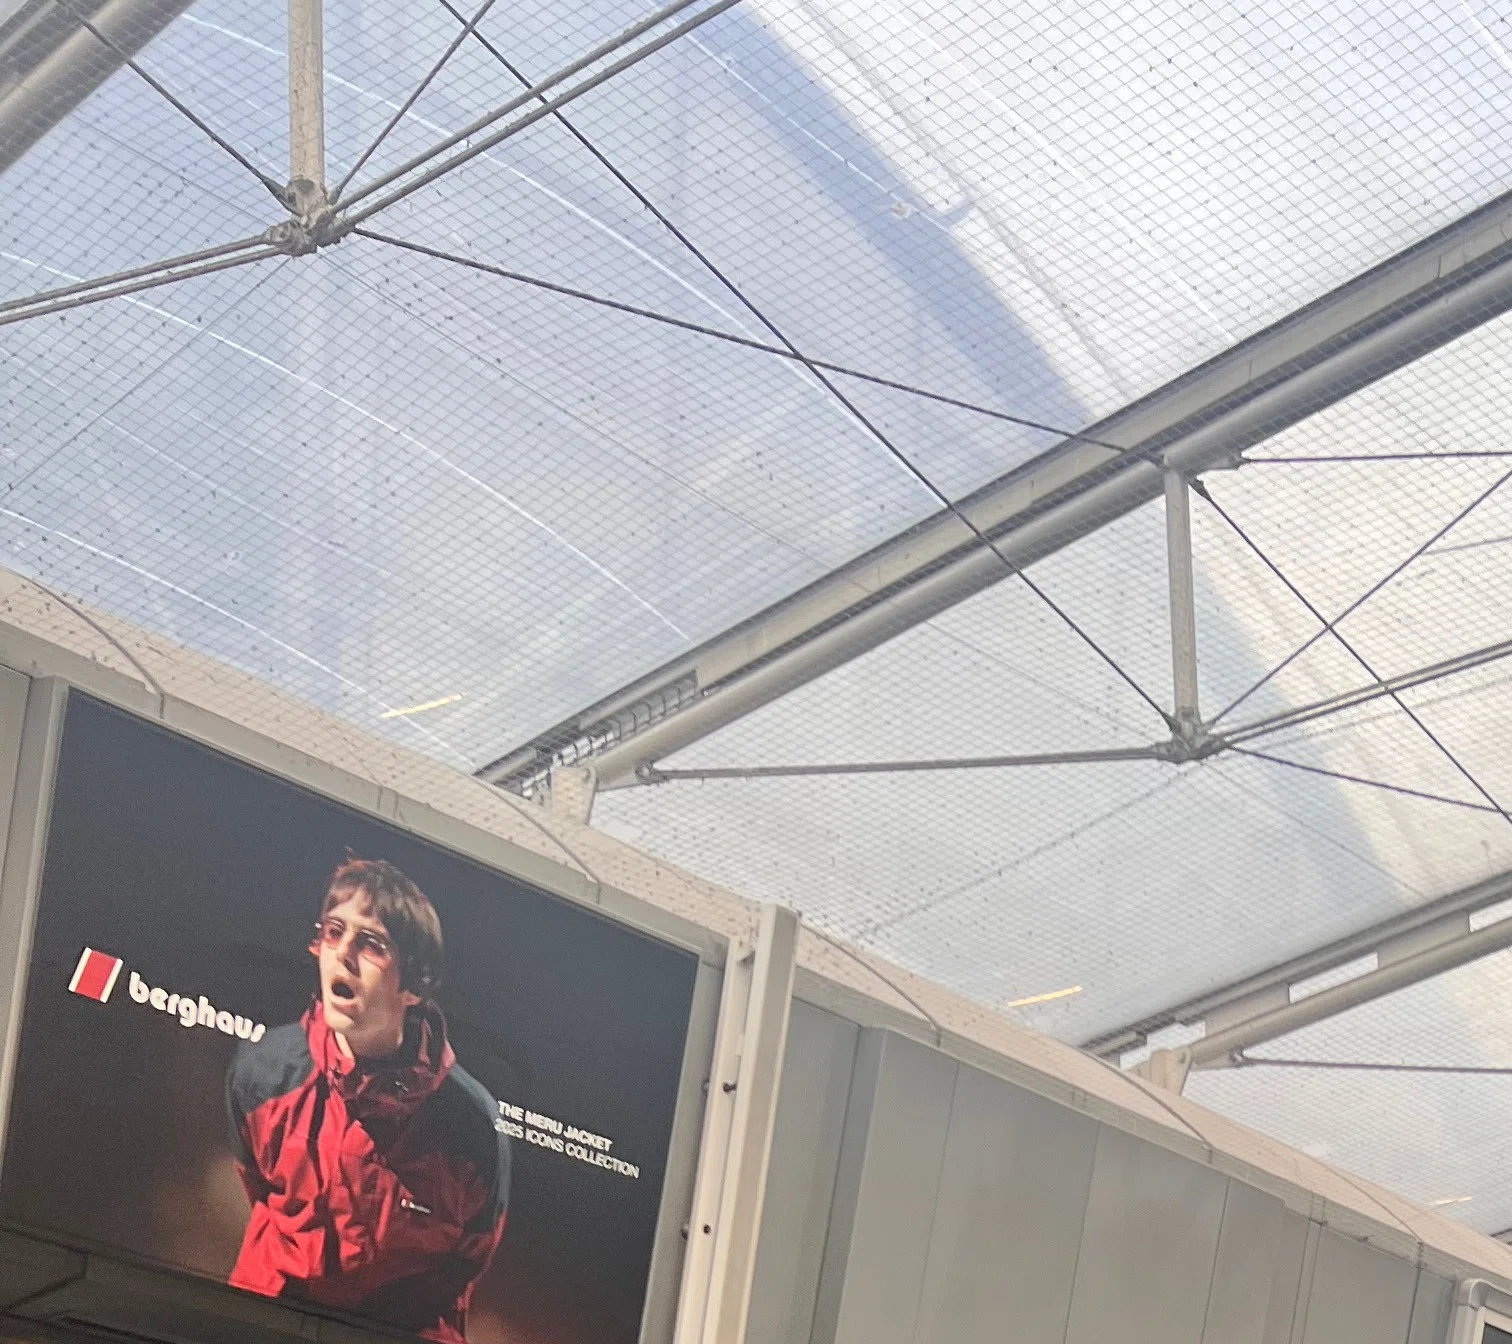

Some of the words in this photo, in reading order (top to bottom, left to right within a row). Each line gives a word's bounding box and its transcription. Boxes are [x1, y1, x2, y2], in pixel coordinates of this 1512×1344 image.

[129, 971, 266, 1043] berghaus
[498, 1100, 524, 1122] THE
[563, 1125, 613, 1152] JACKET
[525, 1128, 564, 1153] ICONS
[565, 1142, 640, 1178] COLLECTION
